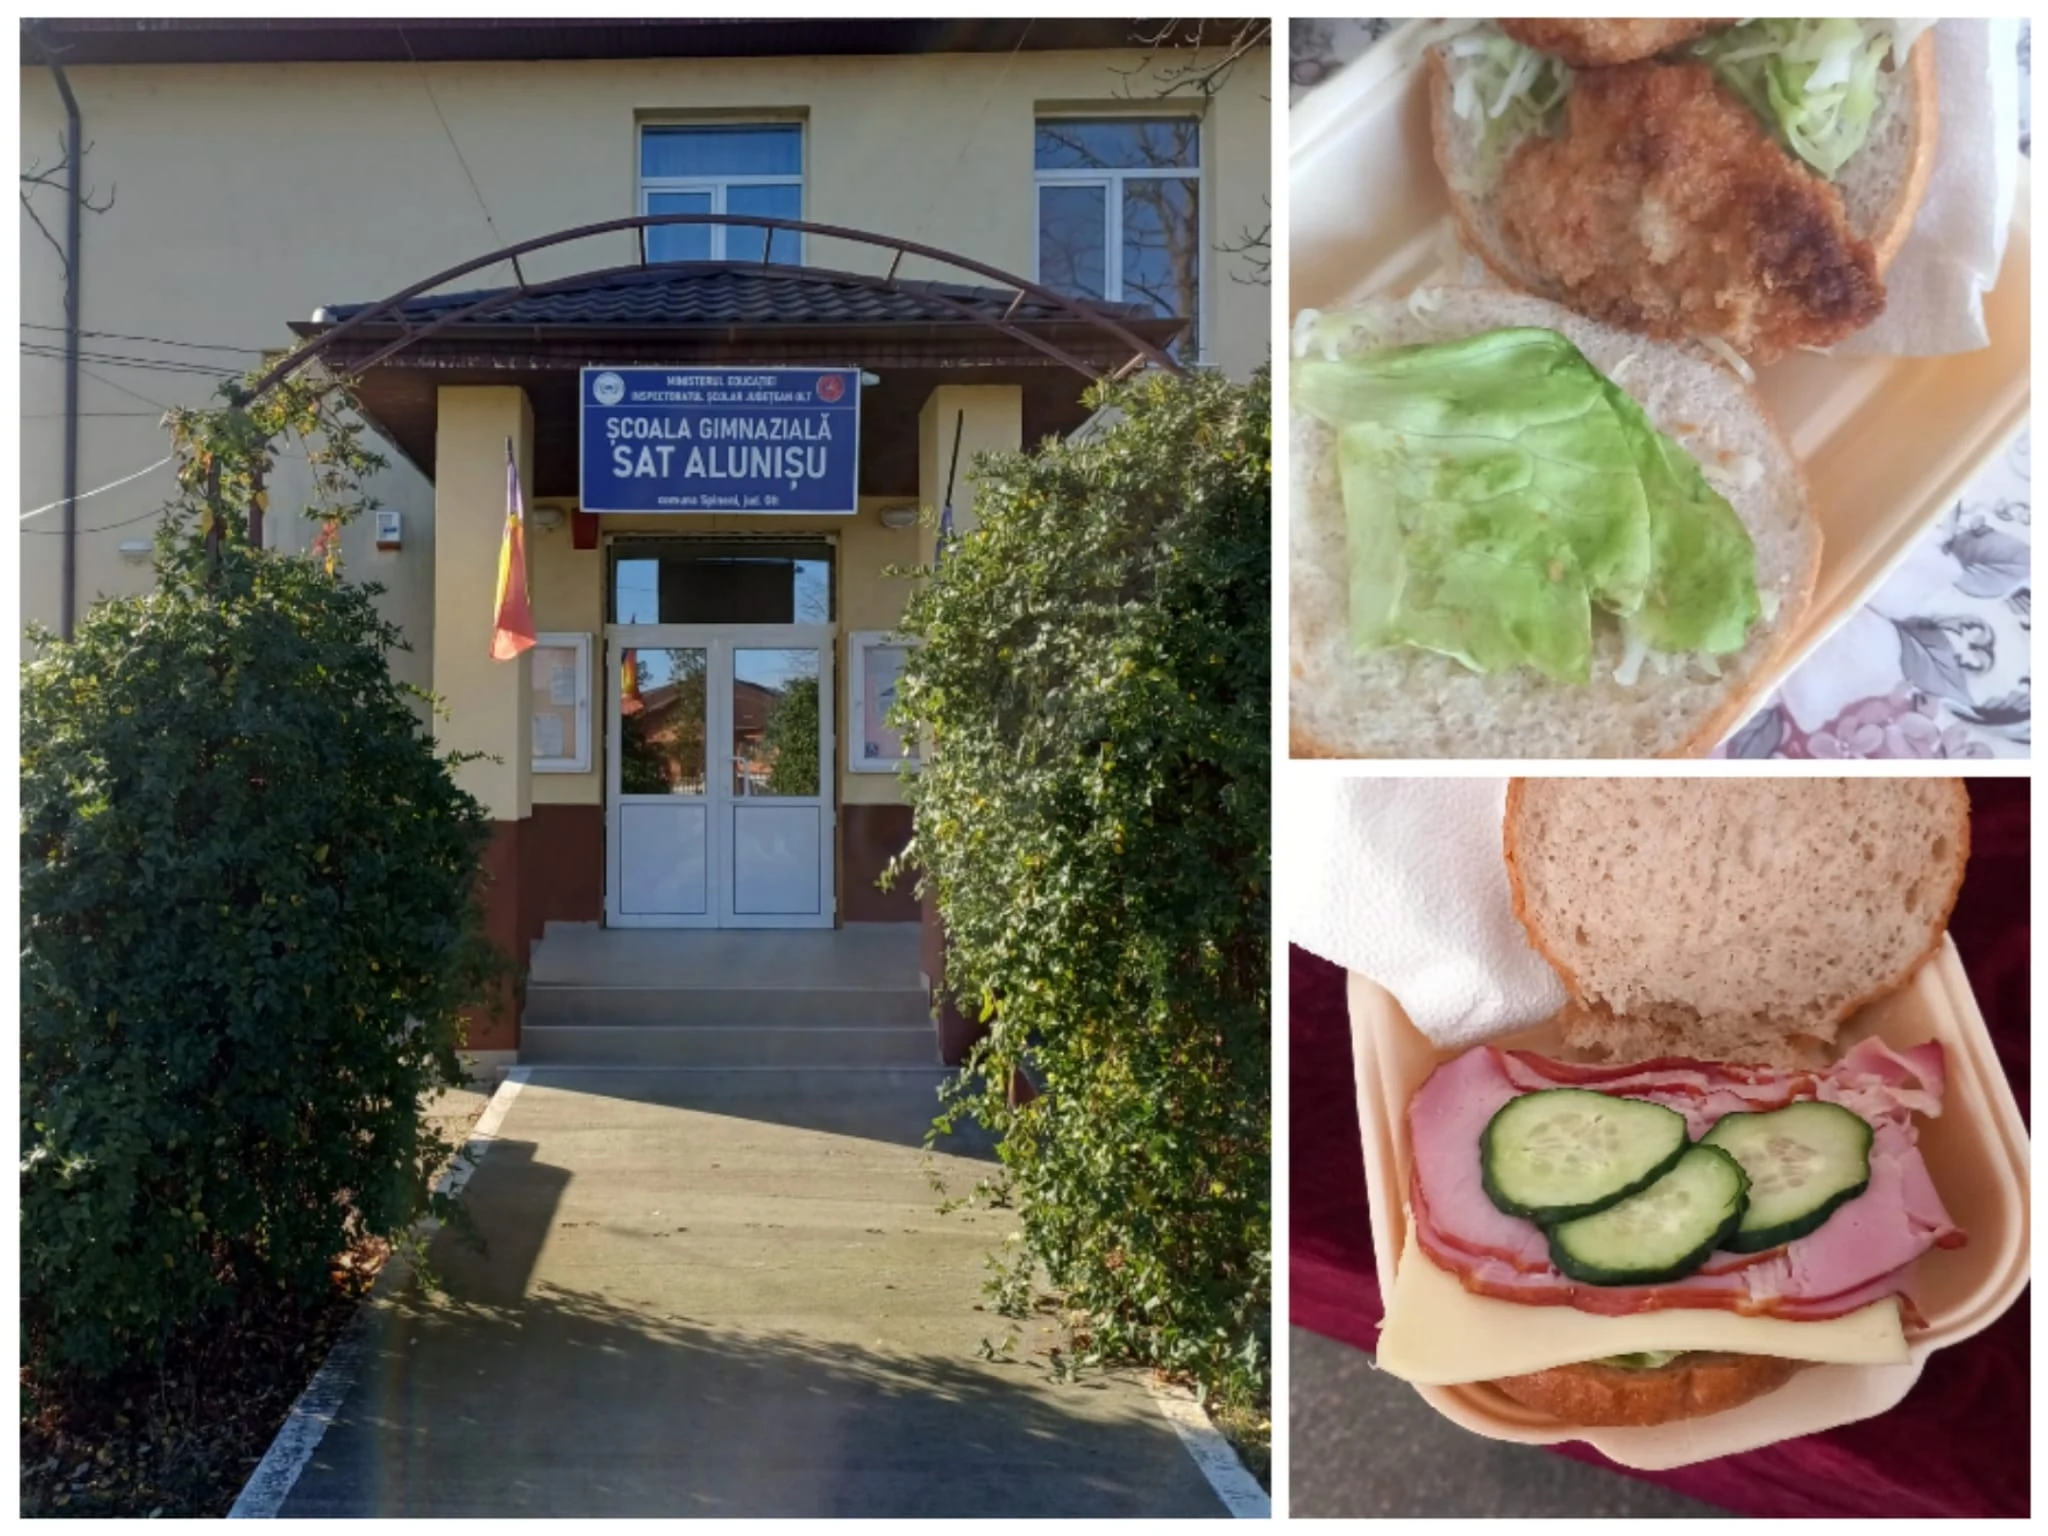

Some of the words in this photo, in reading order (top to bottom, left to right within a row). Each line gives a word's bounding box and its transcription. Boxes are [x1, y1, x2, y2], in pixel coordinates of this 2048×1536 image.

[606, 416, 692, 446] ȘCOALA
[699, 412, 833, 440] GIMNAZIALĂ
[612, 445, 676, 478] SAT
[684, 445, 828, 490] ALUNIȘU
